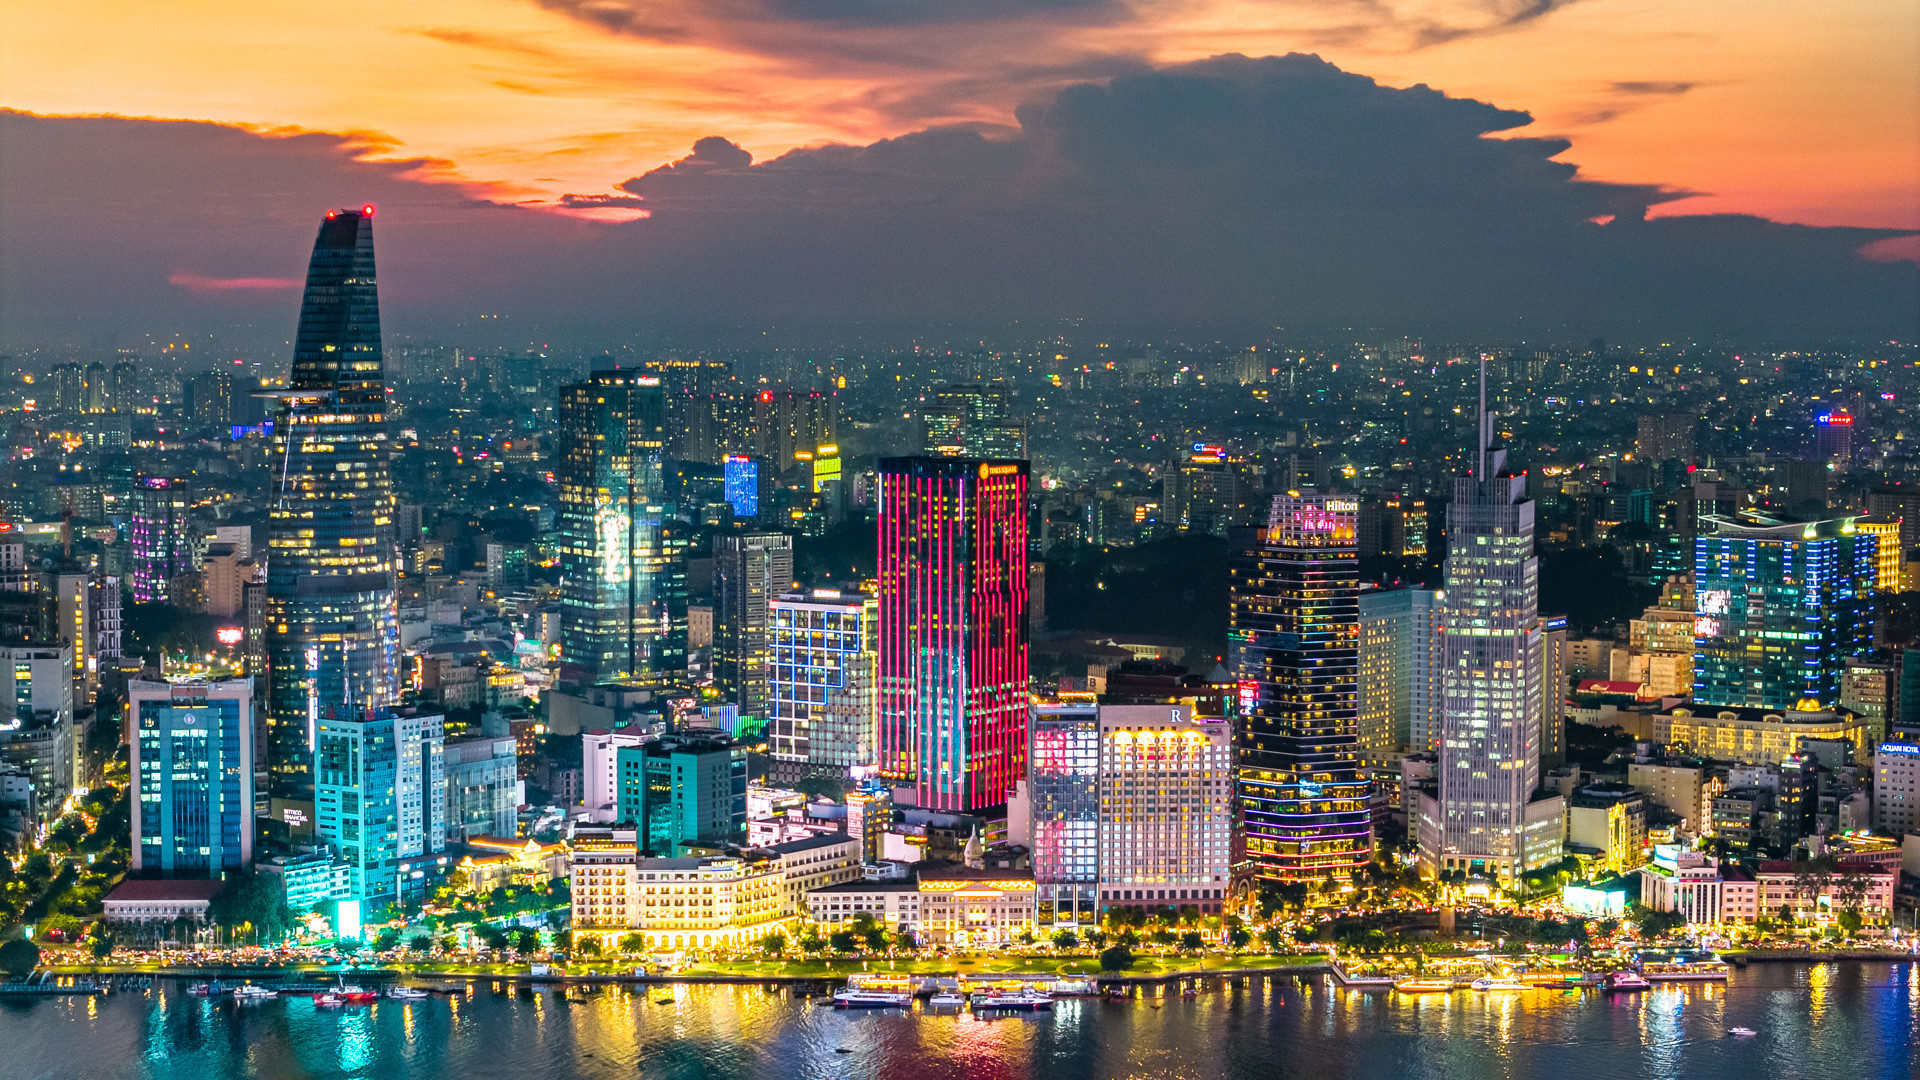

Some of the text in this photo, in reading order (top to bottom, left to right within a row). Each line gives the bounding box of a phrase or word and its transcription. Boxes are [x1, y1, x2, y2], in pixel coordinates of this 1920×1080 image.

[1194, 443, 1205, 451] CT
[1002, 465, 1018, 474] SQUARE
[1326, 500, 1358, 511] Hilton
[1170, 709, 1183, 722] R
